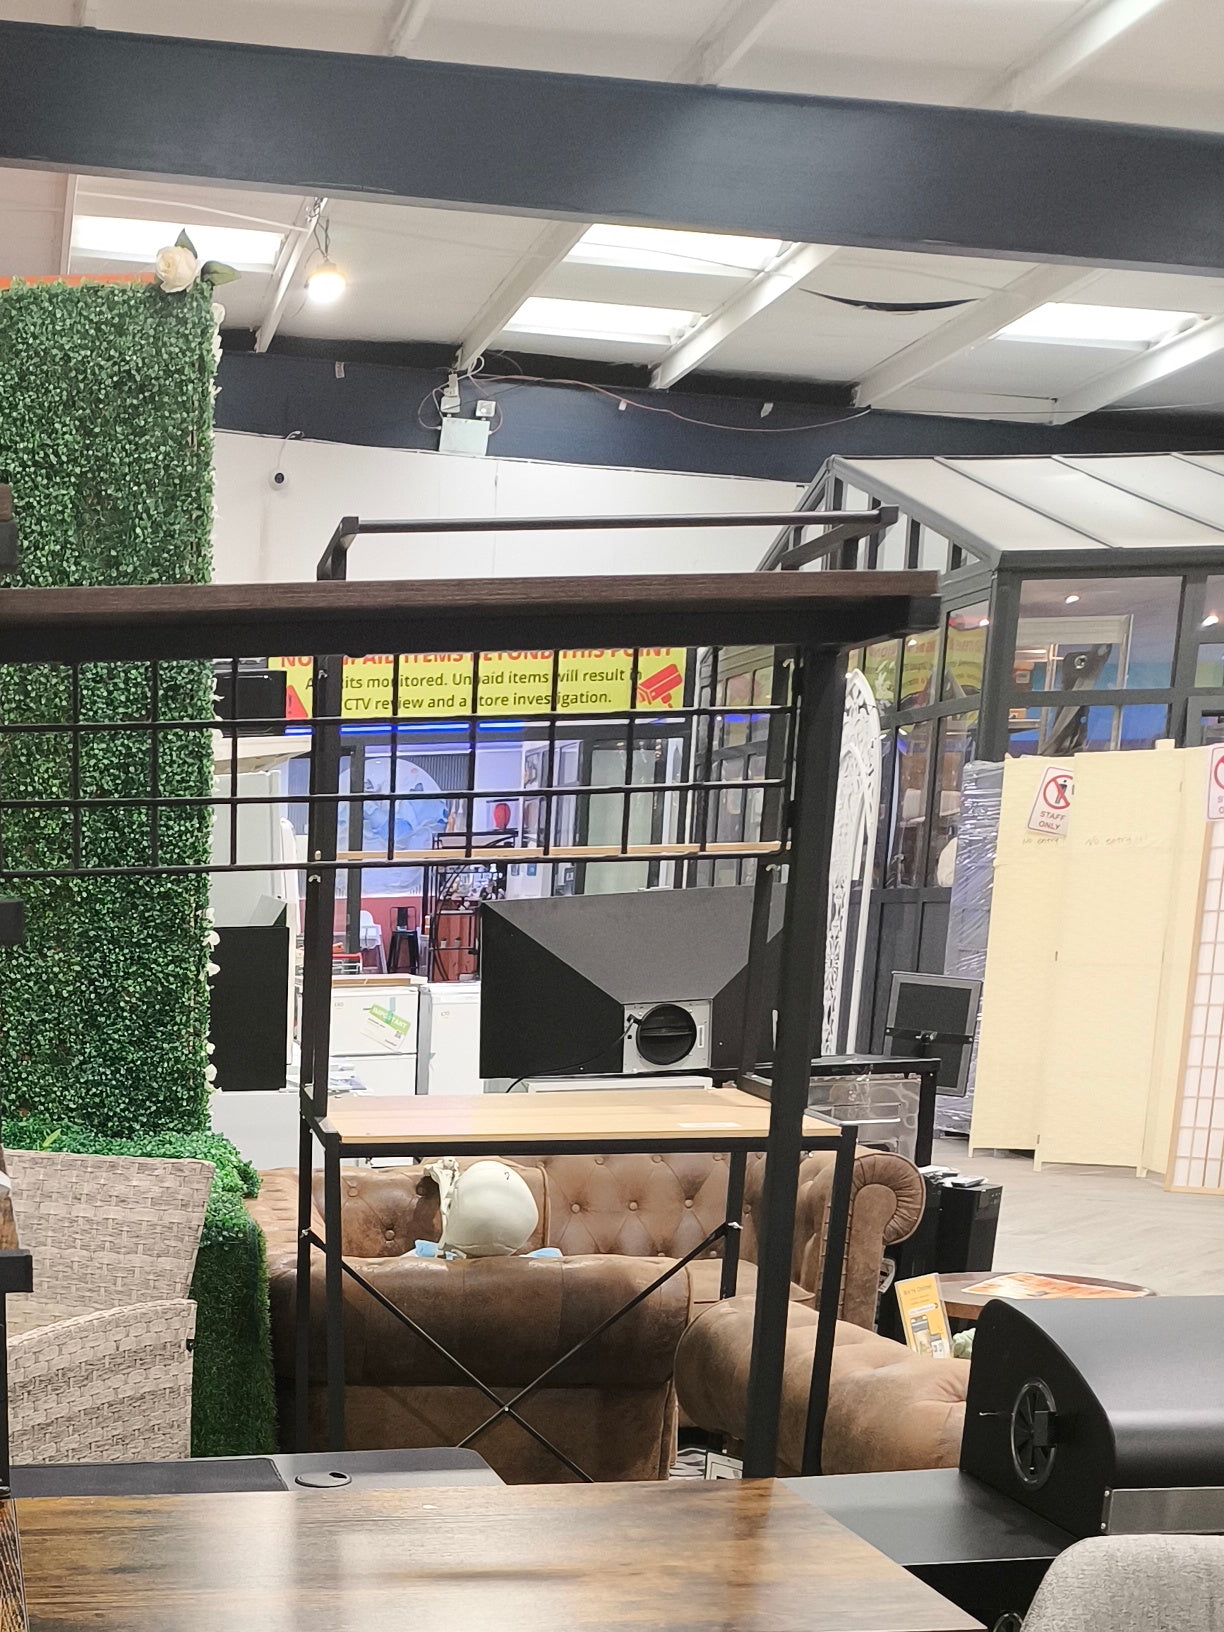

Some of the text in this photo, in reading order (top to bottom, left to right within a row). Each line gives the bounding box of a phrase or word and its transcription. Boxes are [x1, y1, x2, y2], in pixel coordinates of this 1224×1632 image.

[404, 652, 464, 664] ITEMS
[470, 650, 554, 662] EYOND
[562, 649, 605, 659] THIS
[367, 673, 448, 688] moitored.
[453, 671, 504, 686] Unaid
[508, 670, 549, 684] items
[583, 667, 625, 682] result
[344, 691, 612, 711] CTV reiew and a tore invesigation.
[1040, 810, 1066, 821] STAFF
[1038, 820, 1061, 830] ONLY
[372, 1006, 408, 1029] IMPOTANT
